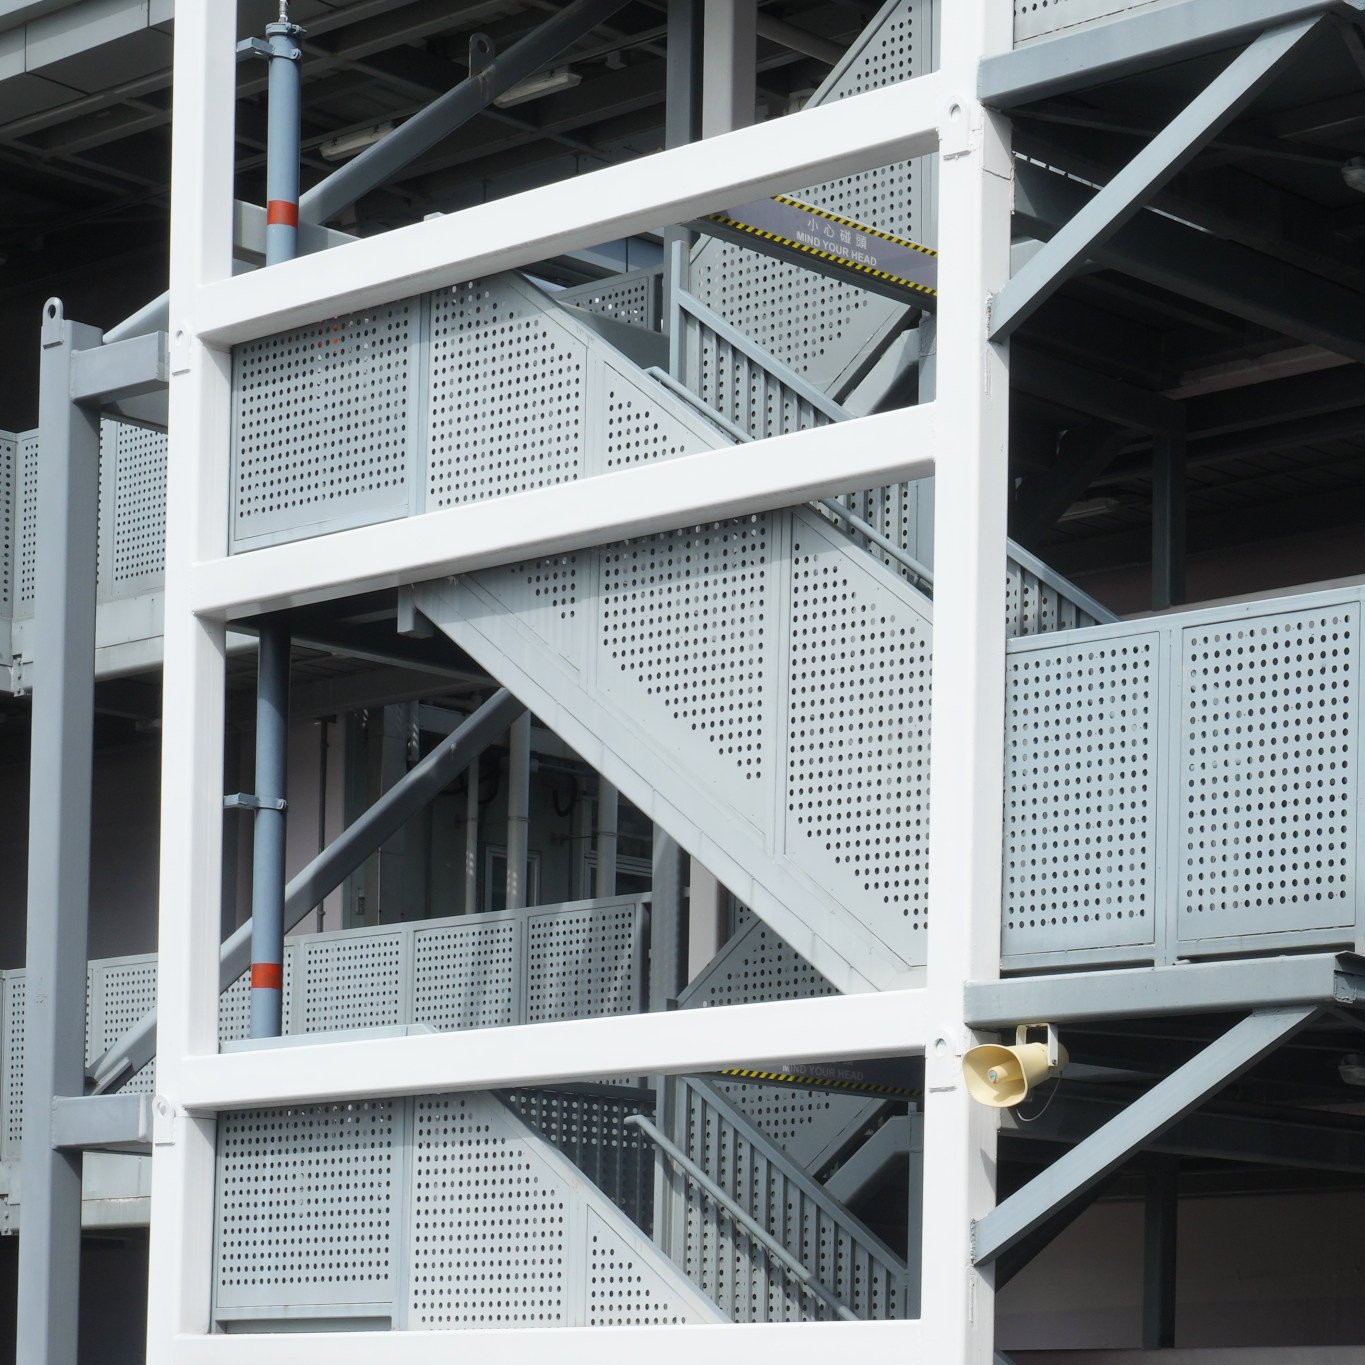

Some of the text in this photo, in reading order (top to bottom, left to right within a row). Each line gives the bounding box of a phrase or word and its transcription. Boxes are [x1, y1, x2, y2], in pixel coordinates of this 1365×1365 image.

[796, 230, 877, 267] MIND YOUR HEAD
[807, 217, 868, 250] 小心碰頭
[782, 1064, 864, 1081] MIND YOUR HEAD
